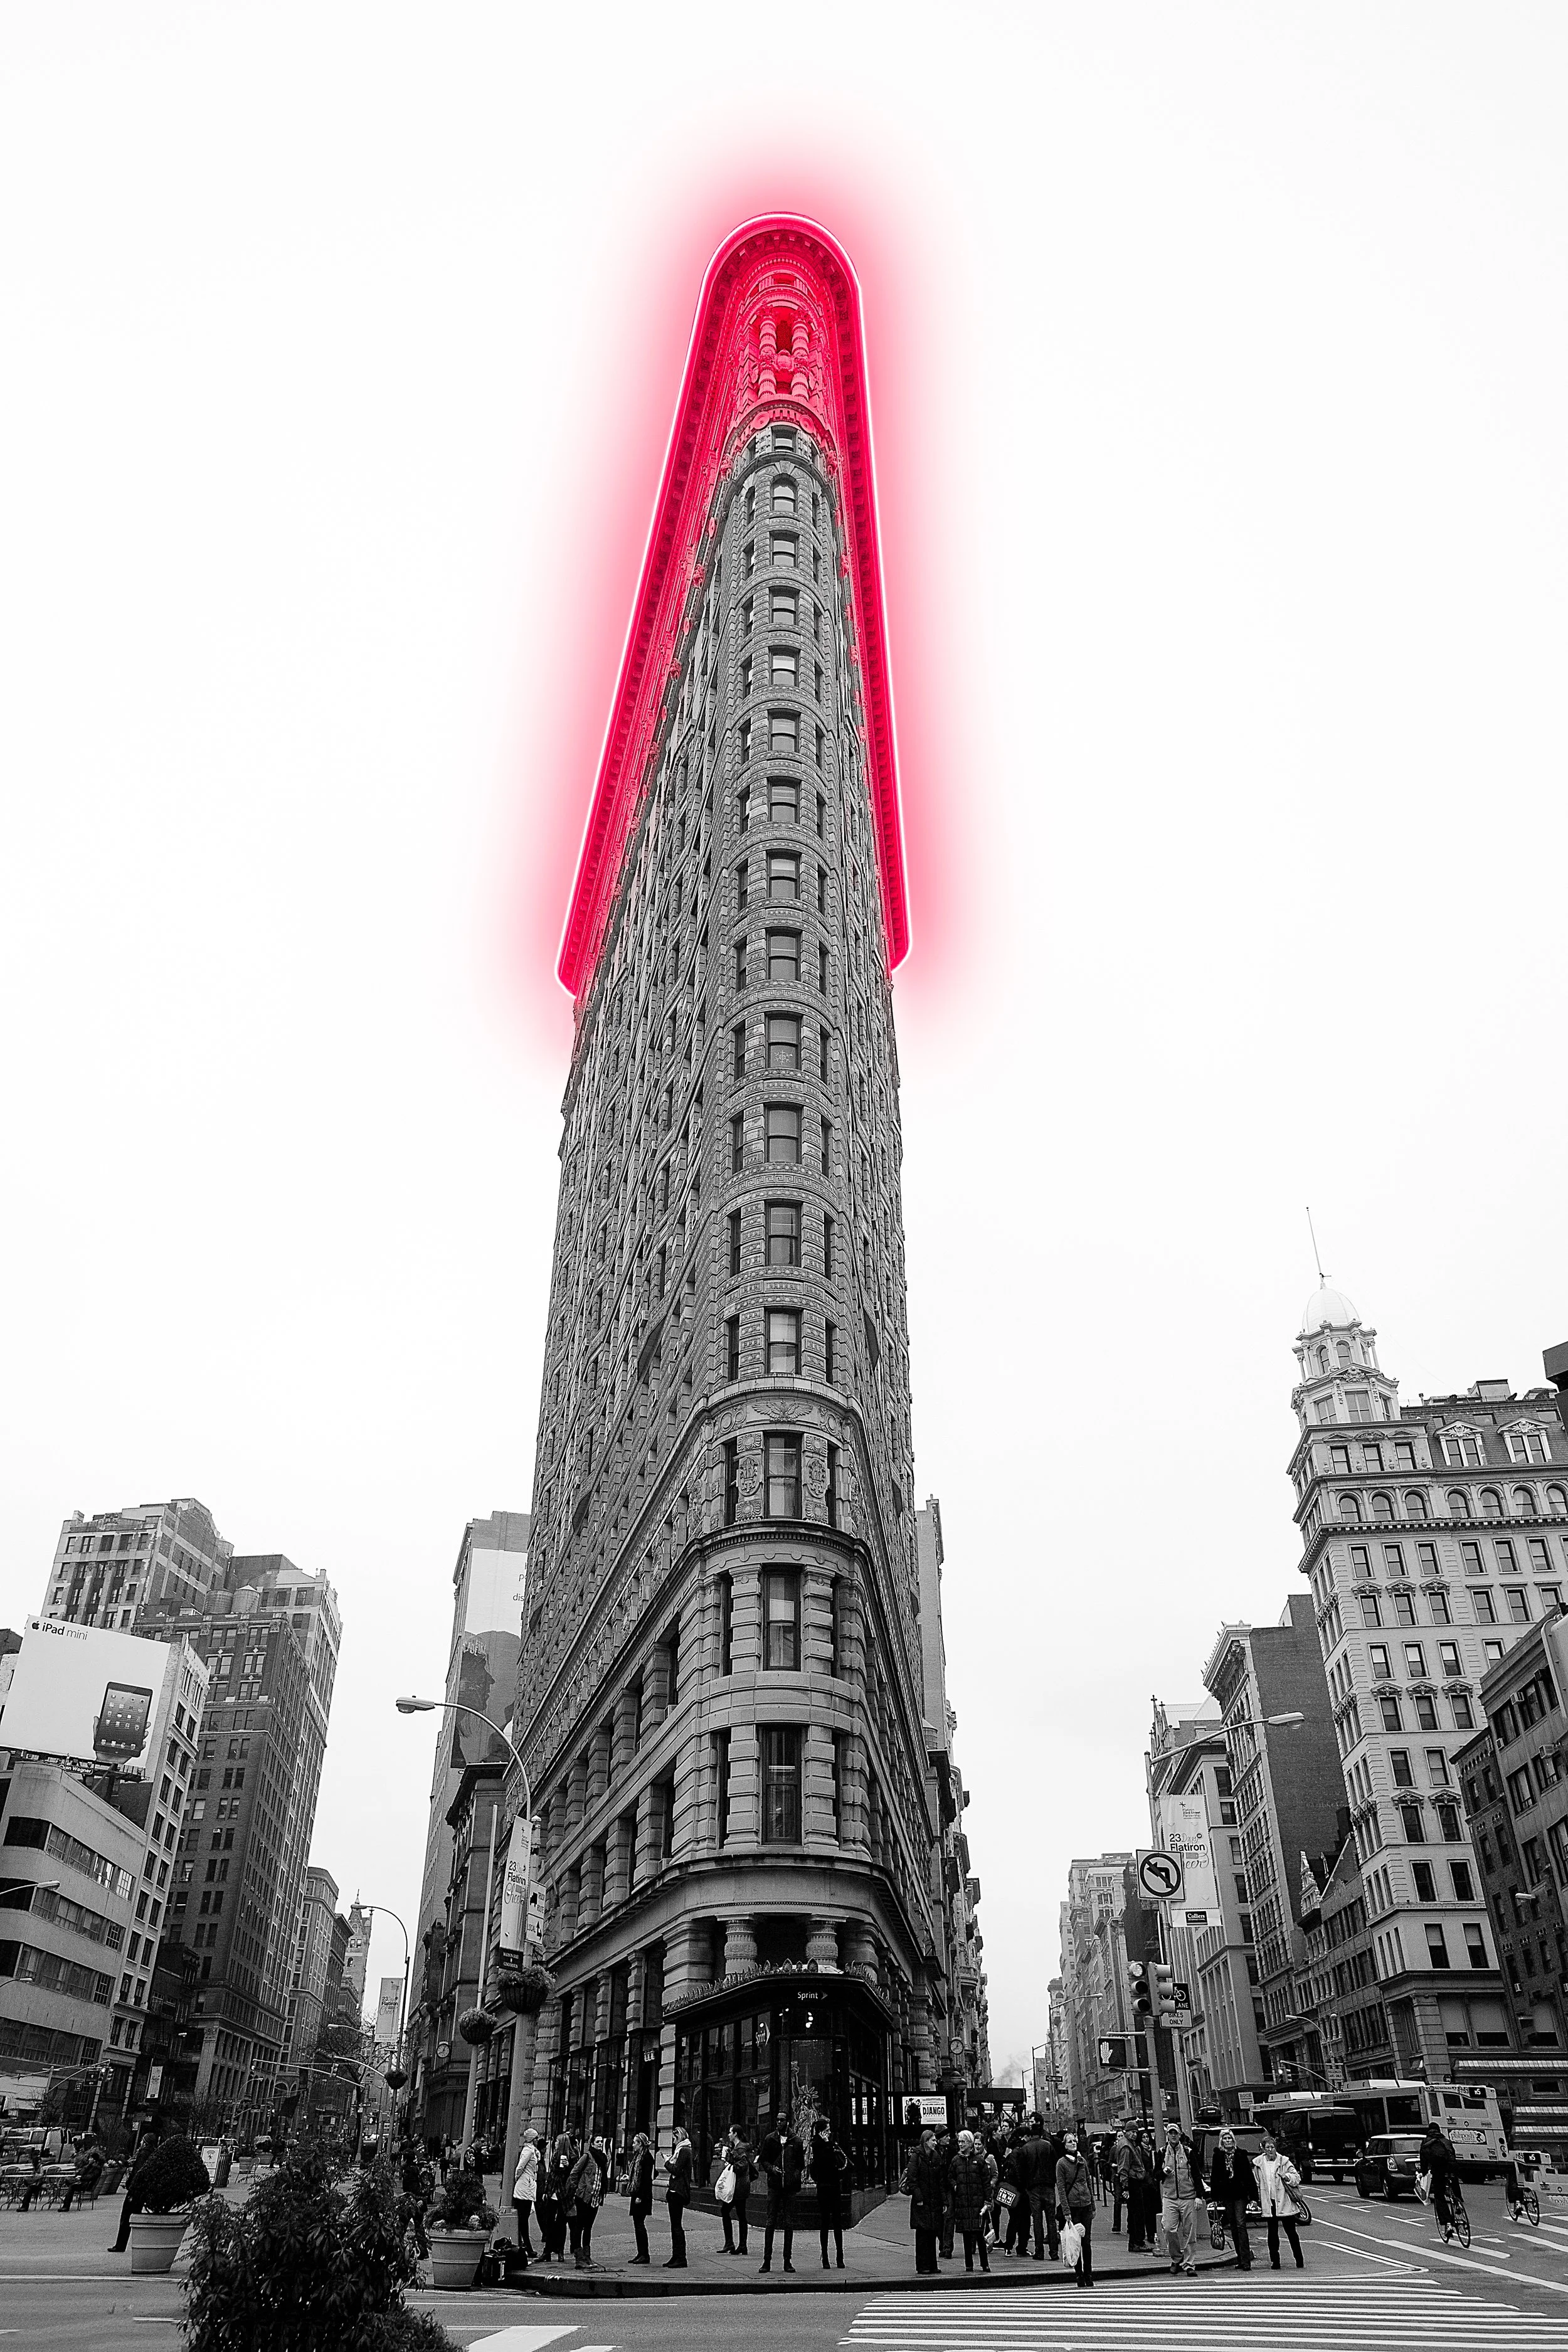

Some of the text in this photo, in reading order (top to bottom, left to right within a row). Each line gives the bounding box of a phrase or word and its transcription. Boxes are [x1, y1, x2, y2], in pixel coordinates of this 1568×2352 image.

[42, 1622, 88, 1640] iPad mini
[1169, 1833, 1181, 1843] 23
[1170, 1843, 1205, 1851] Flatiron
[509, 1860, 516, 1872] 23
[507, 1872, 526, 1886] Flatiron
[797, 1991, 818, 2000] Sprint
[923, 2107, 945, 2115] DJANGO
